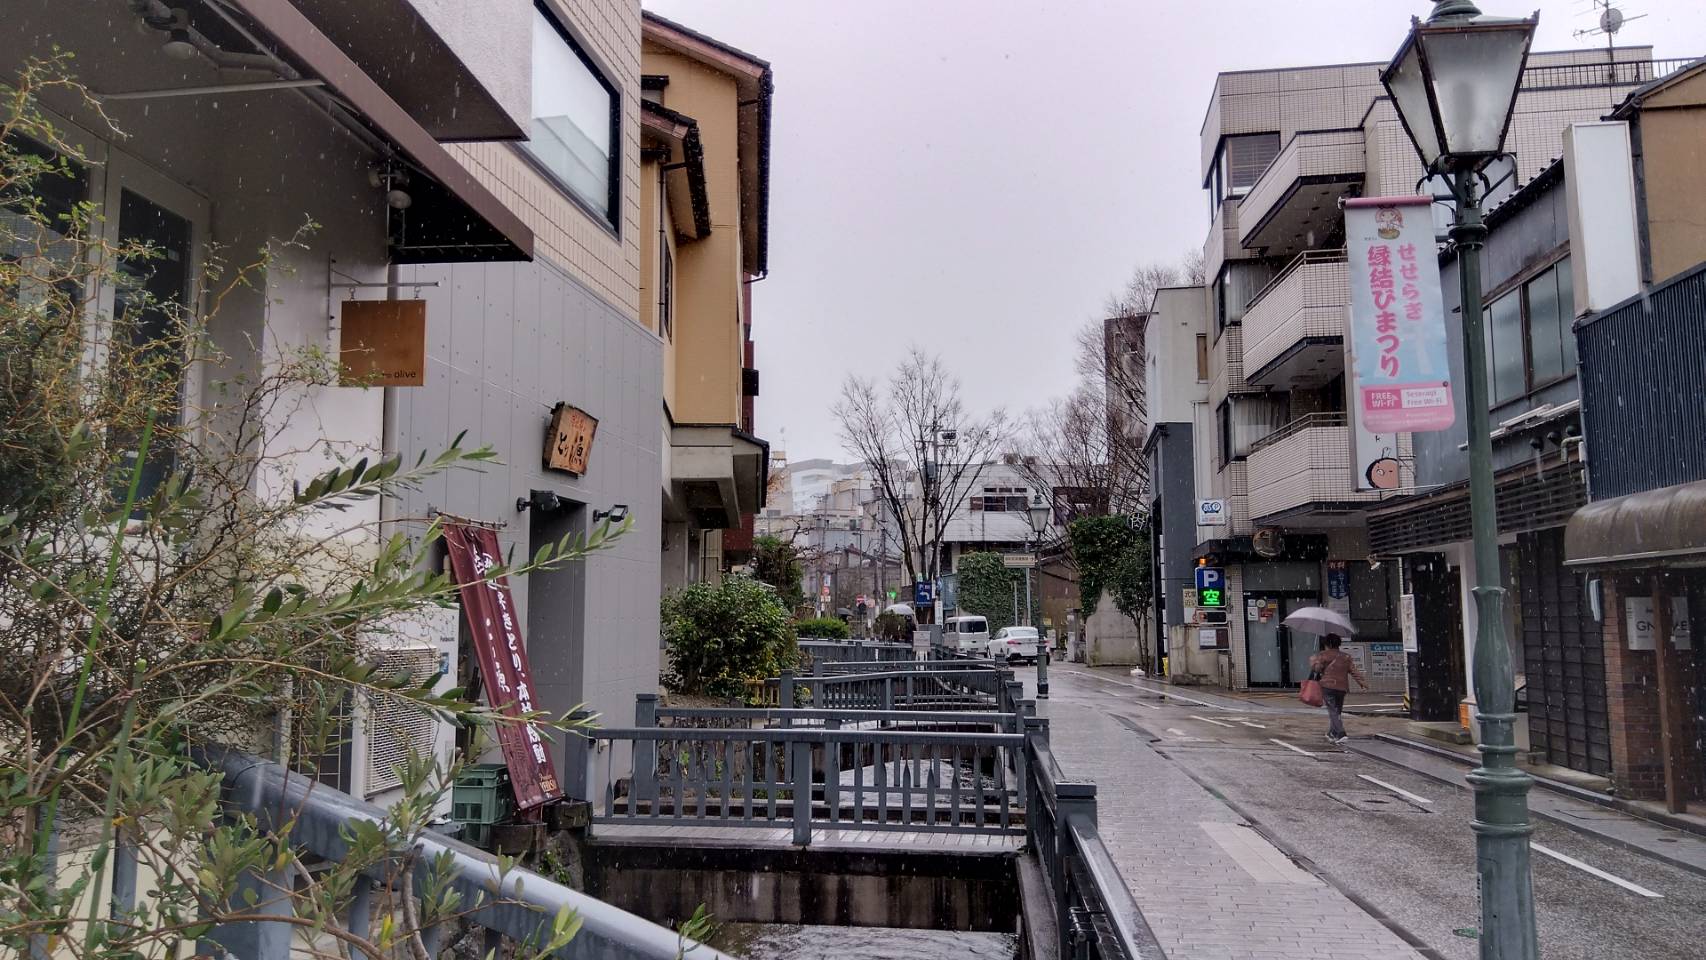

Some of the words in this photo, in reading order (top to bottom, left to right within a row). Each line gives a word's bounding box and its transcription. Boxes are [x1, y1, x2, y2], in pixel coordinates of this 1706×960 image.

[1398, 243, 1422, 321] せせらぎ
[1367, 245, 1401, 378] 縁結びまつり
[394, 369, 416, 378] olive
[1371, 392, 1393, 400] FREE
[1203, 570, 1219, 587] P
[1203, 589, 1220, 605] 空
